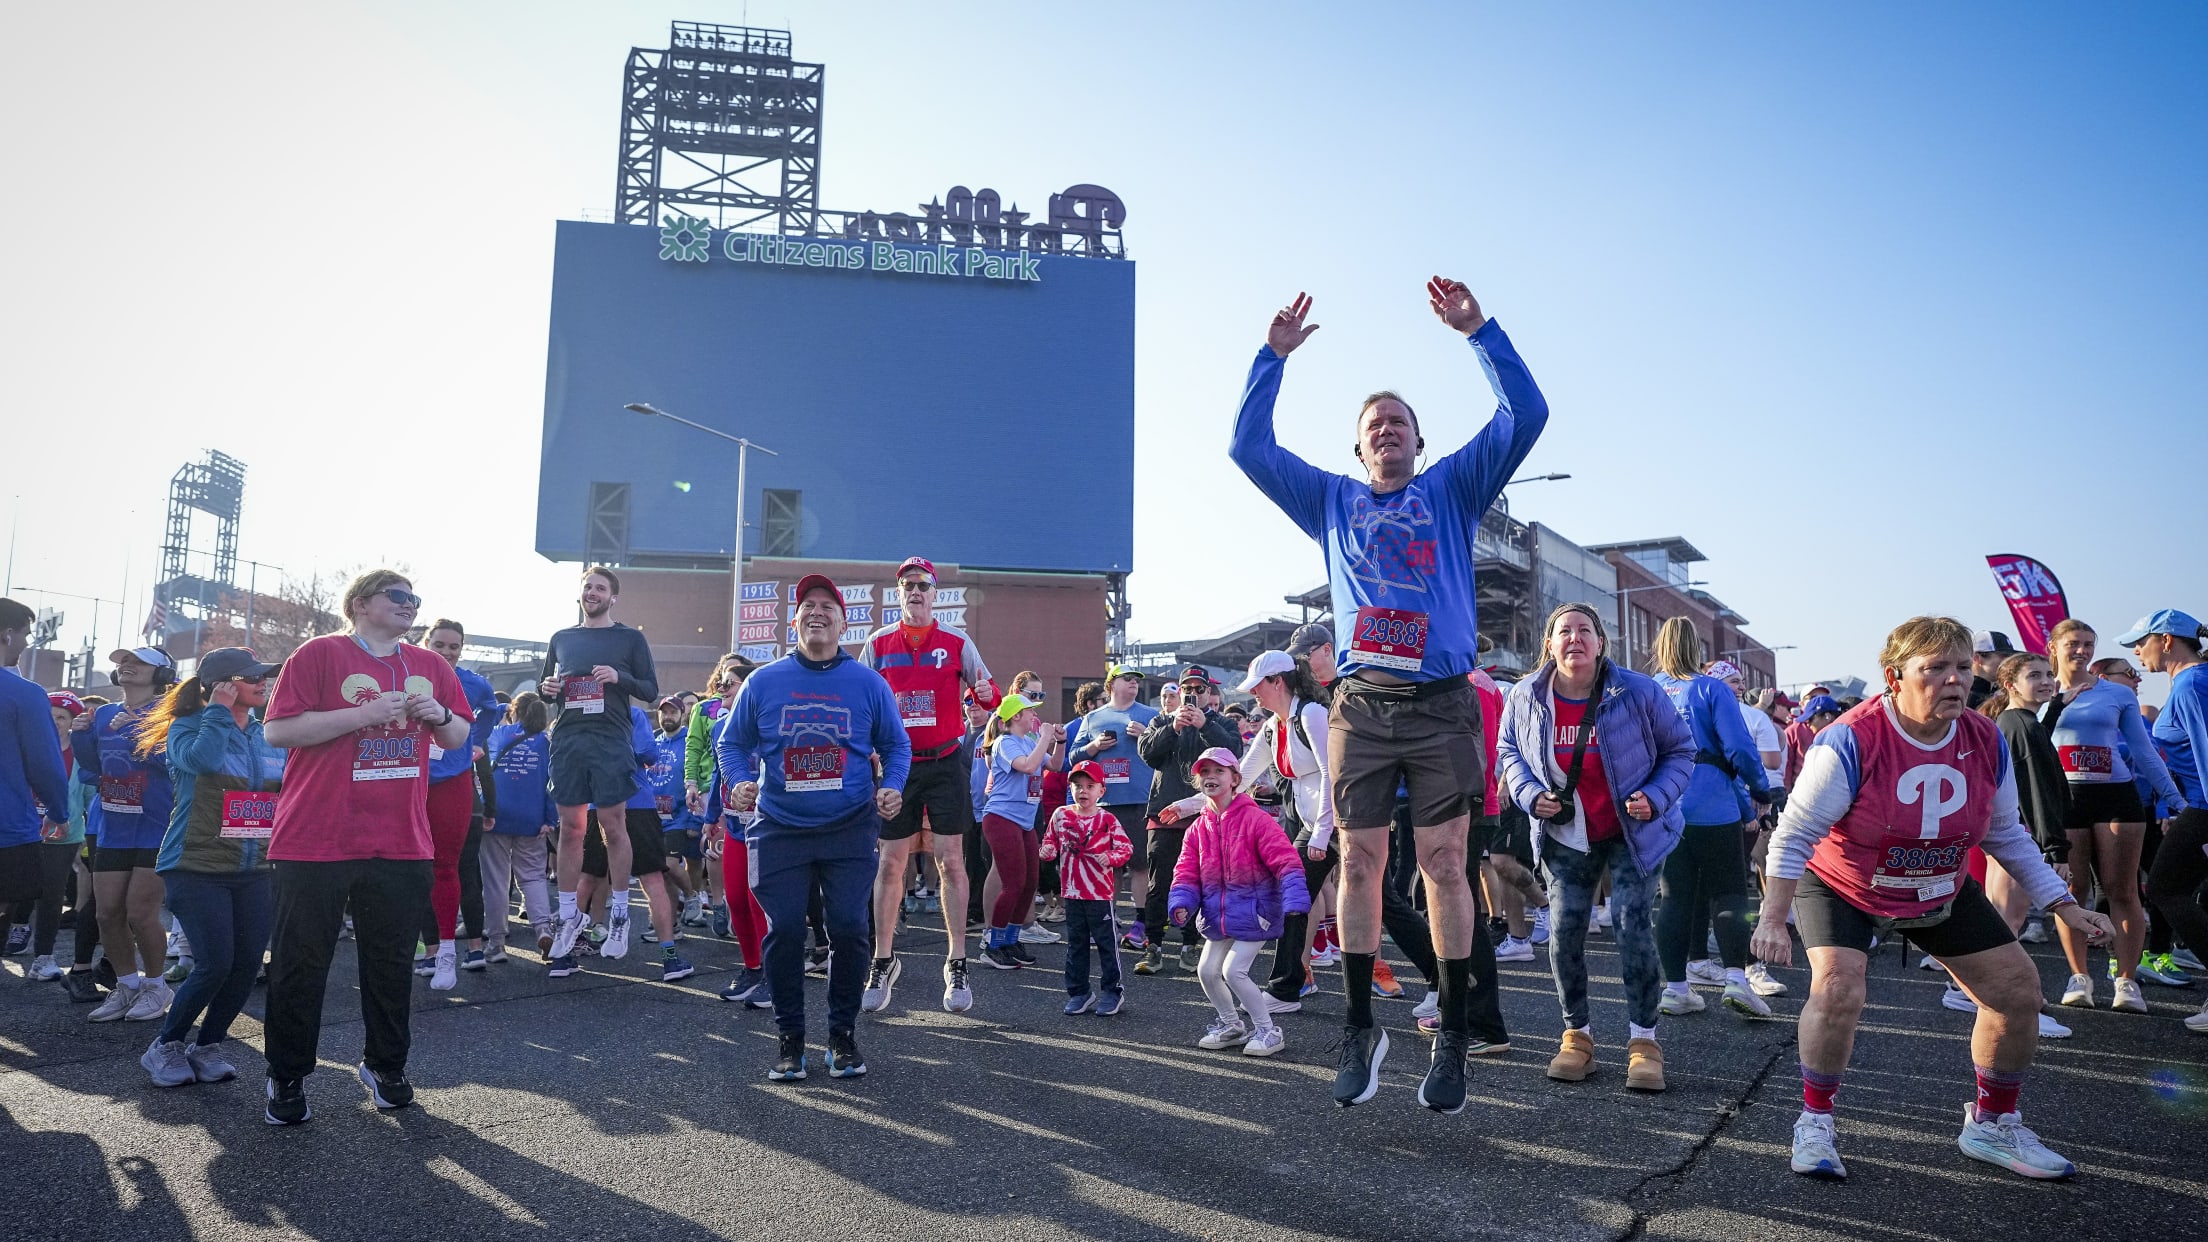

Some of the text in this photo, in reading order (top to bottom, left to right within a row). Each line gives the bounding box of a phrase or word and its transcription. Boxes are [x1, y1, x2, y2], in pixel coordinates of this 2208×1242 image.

[723, 232, 1041, 281] Citizens Bank Park
[1407, 540, 1438, 567] 5K
[743, 584, 772, 597] 1915
[1992, 560, 2060, 600] 5K
[743, 605, 771, 619] 1980
[846, 609, 866, 620] 983
[741, 626, 770, 639] 2008
[1360, 616, 1420, 648] 2938
[931, 648, 948, 669] P
[569, 681, 599, 696] 2789
[900, 696, 931, 713] 1335
[359, 737, 414, 760] 2909
[791, 752, 835, 773] 1450
[1079, 760, 1090, 770] P
[229, 799, 275, 821] 5839
[1896, 763, 1968, 839] P
[1886, 846, 1959, 869] 3863
